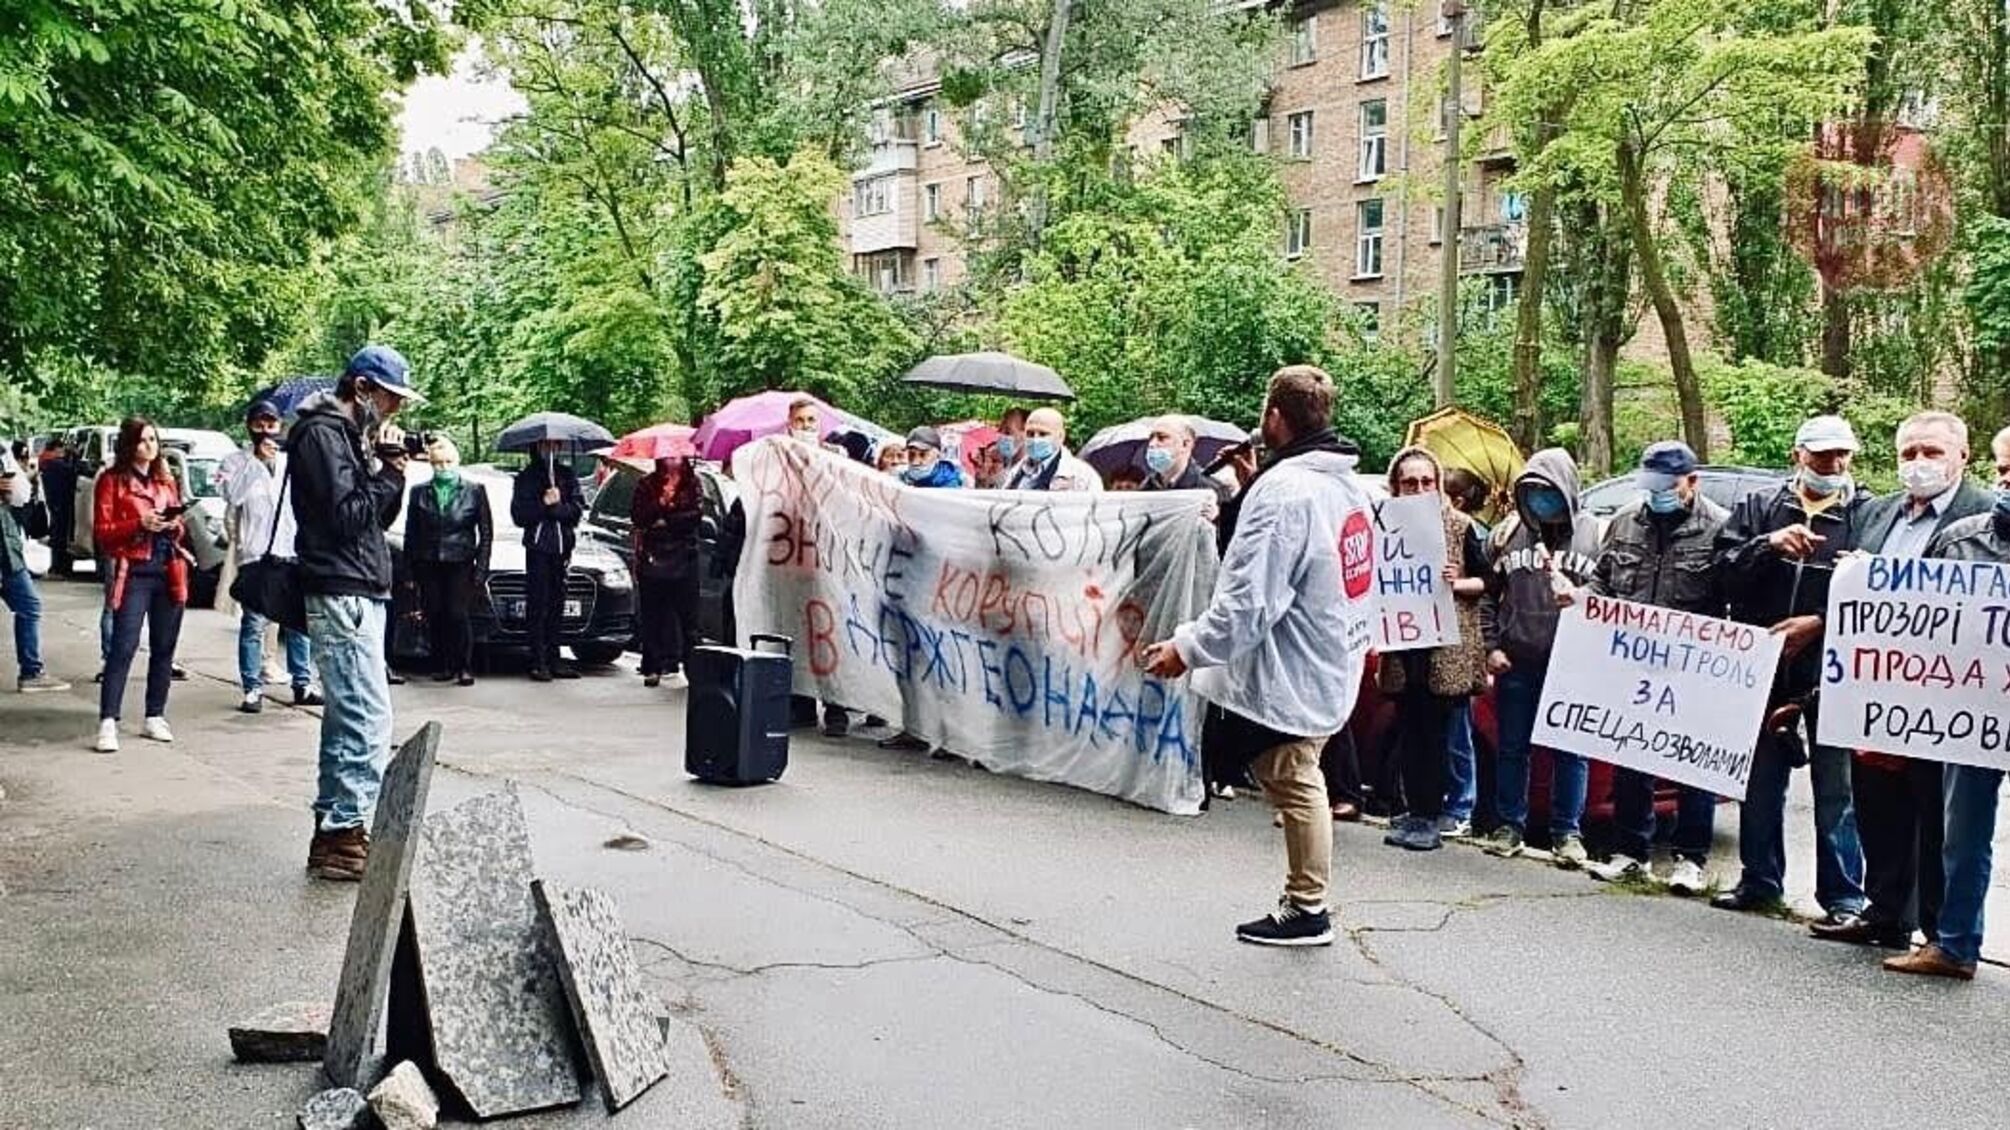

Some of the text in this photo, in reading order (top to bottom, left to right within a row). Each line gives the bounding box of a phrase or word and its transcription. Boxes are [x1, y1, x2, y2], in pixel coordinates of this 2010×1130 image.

[989, 500, 1151, 578] КОЛИ
[1867, 557, 2010, 599] ВИМАГА
[806, 599, 838, 676] В
[1585, 596, 1755, 652] ВИМАГАЄМО
[1838, 600, 1963, 645] ПРОЗОРІ
[1610, 630, 1757, 688] КОНТРОЛЬ
[1854, 648, 2010, 693] ПРОДА
[1632, 680, 1677, 716] ЗА
[1864, 702, 2010, 752] РОДОВ
